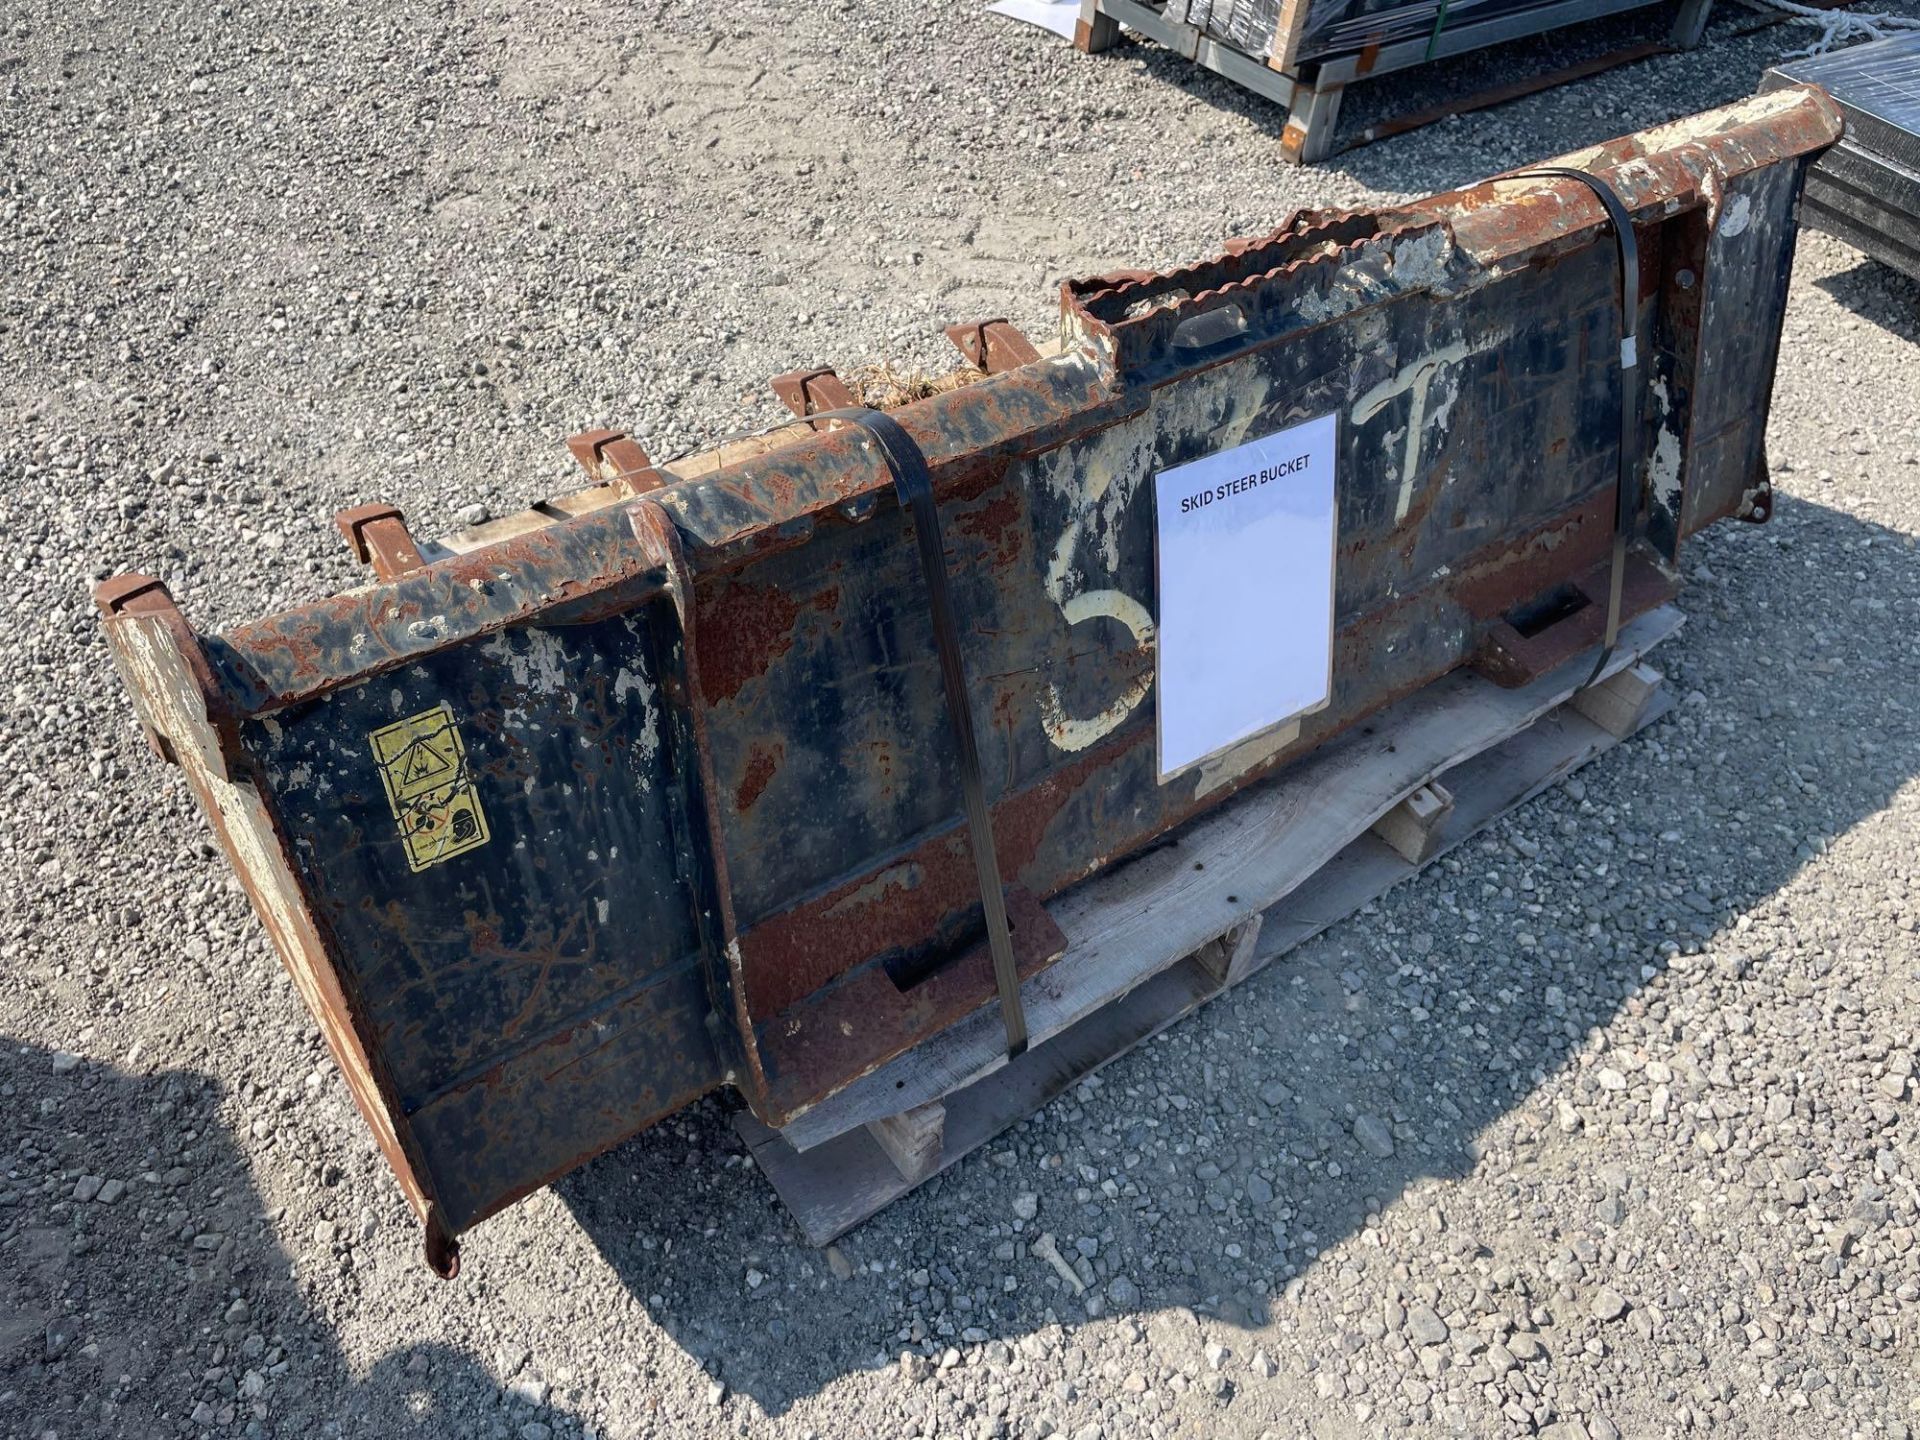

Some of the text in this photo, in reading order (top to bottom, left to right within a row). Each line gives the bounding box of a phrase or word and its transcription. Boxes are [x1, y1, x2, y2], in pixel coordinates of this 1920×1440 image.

[1181, 454, 1311, 513] SKID STEER BUCKET
